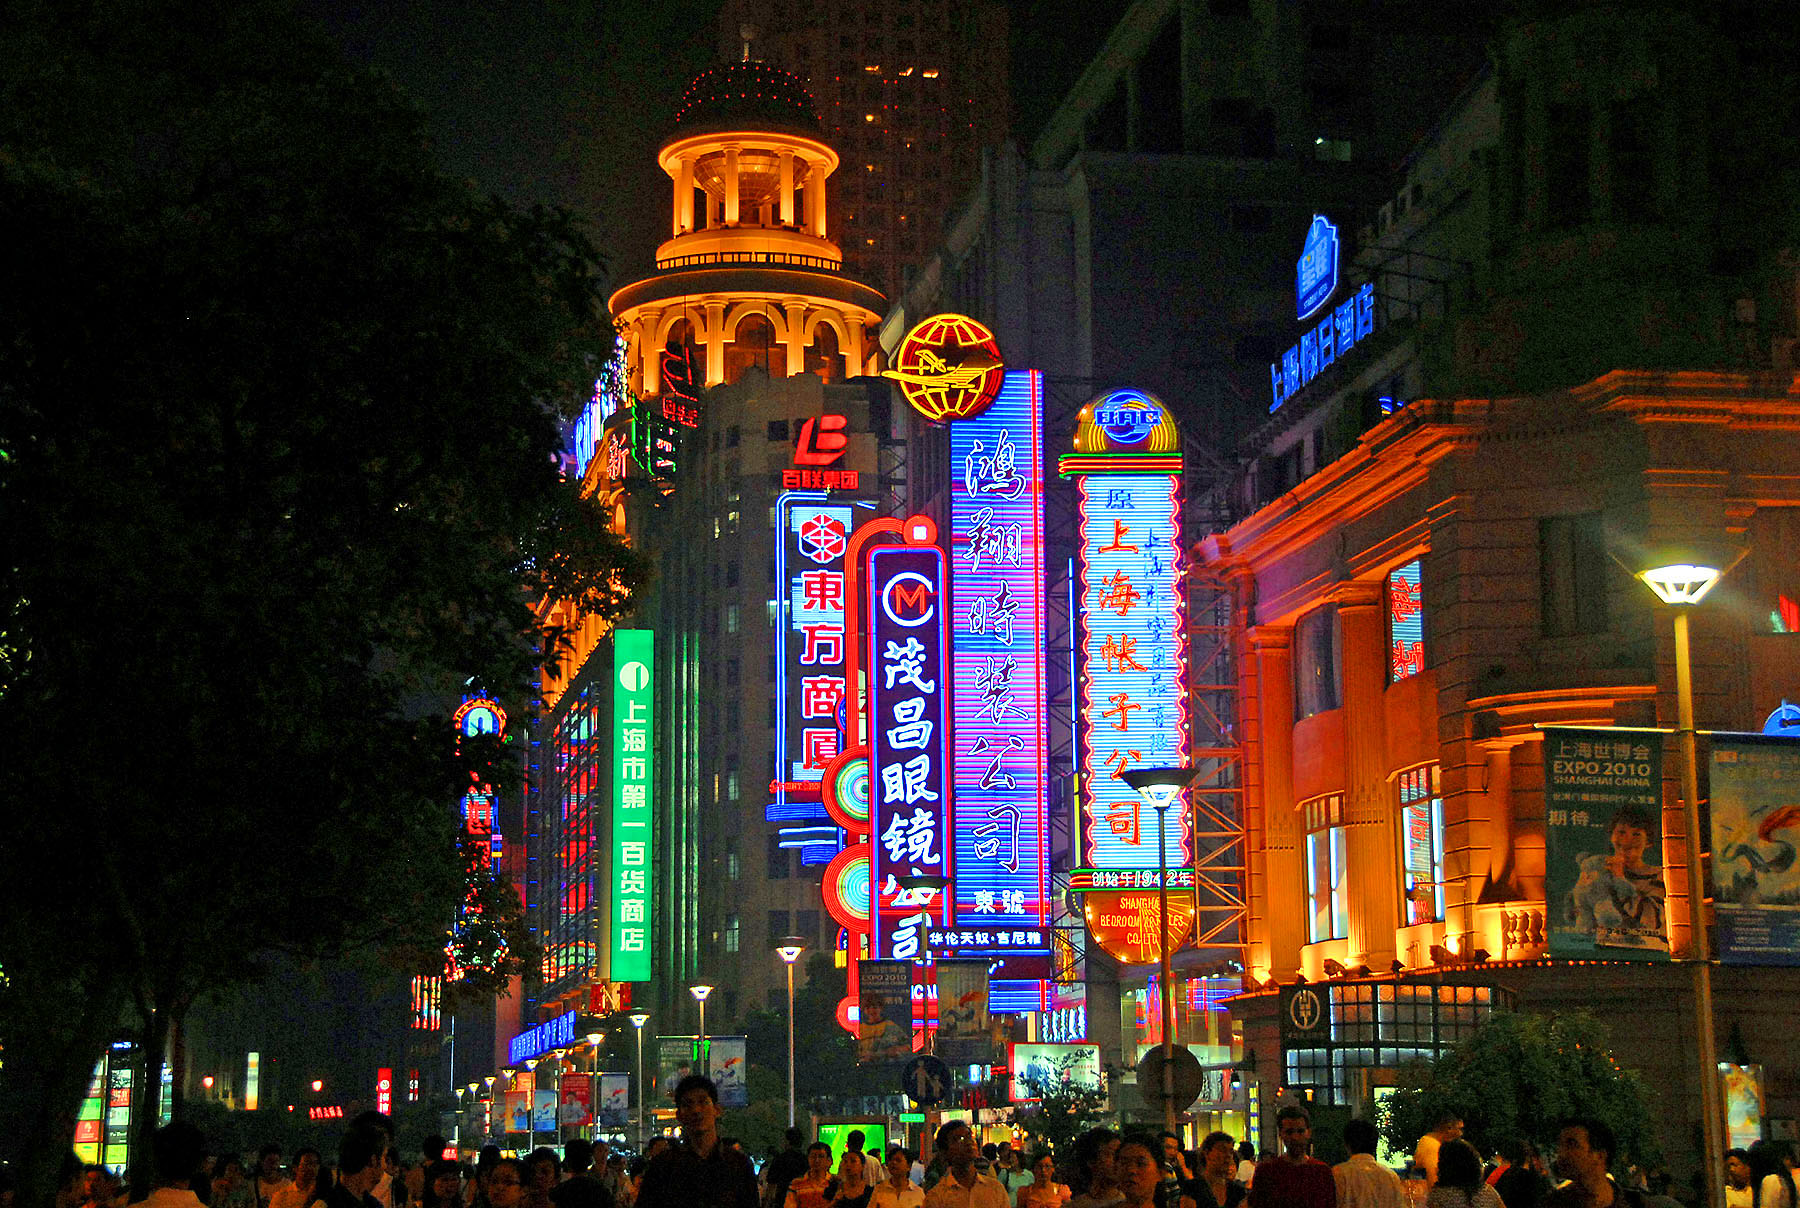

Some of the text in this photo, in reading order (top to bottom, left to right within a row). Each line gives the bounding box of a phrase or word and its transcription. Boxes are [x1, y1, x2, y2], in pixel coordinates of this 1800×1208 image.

[782, 469, 859, 490] 百联集团
[1556, 741, 1649, 760] 上海世博会
[1553, 760, 1651, 777] EXPO 2010
[1553, 775, 1650, 788] SHANGHAI CHINA
[620, 700, 647, 952] 上海市第一百货商店
